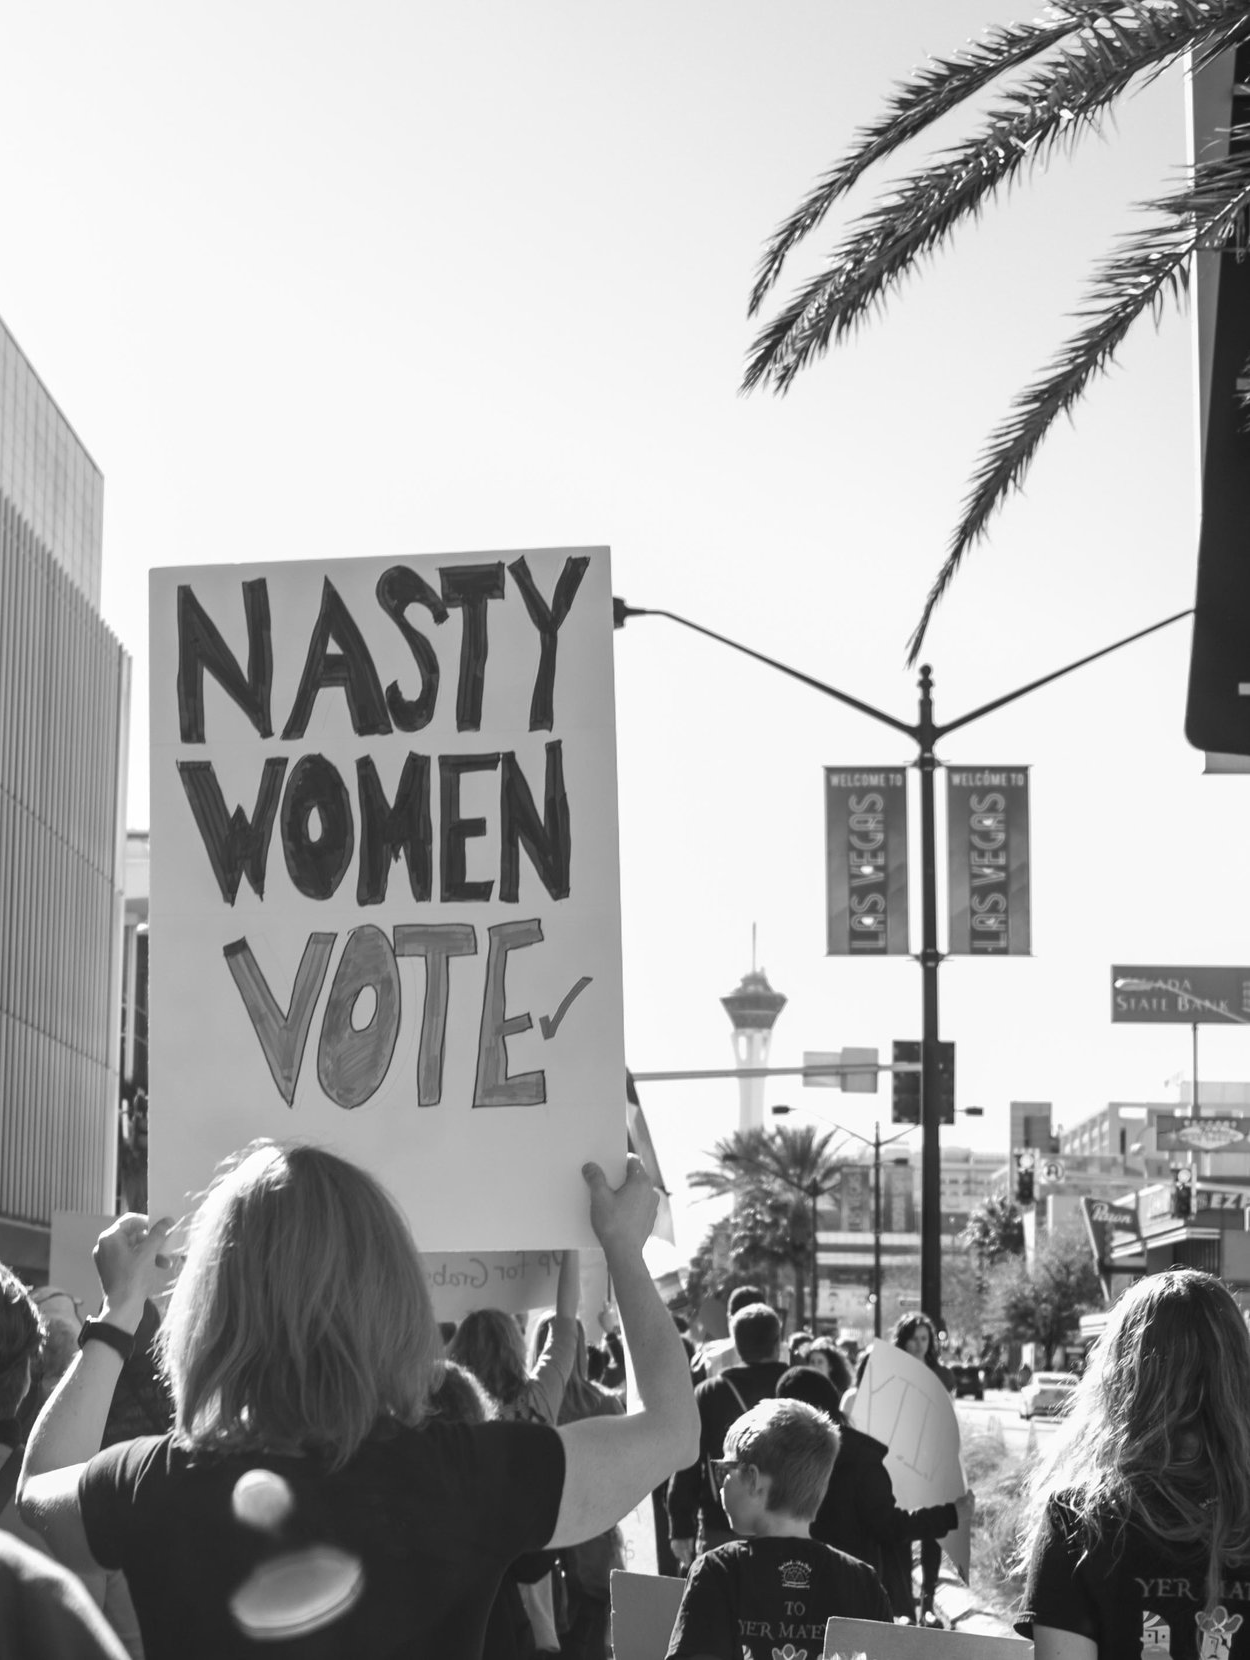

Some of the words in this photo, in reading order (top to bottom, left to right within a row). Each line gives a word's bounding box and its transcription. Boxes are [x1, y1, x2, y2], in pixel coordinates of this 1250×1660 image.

[176, 555, 592, 743] NASTY
[830, 773, 886, 787] WELCOME
[889, 773, 903, 786] TO
[952, 773, 1007, 787] WELCOME
[1010, 773, 1025, 787] TO
[176, 739, 572, 907] WOMEN
[848, 793, 885, 886] VEGAS
[969, 793, 1006, 886] VEGAS
[850, 893, 886, 948] LAS
[972, 893, 1007, 948] LAS
[222, 918, 548, 1109] VOTE
[784, 1601, 806, 1616] TO
[1135, 1577, 1198, 1602] YER
